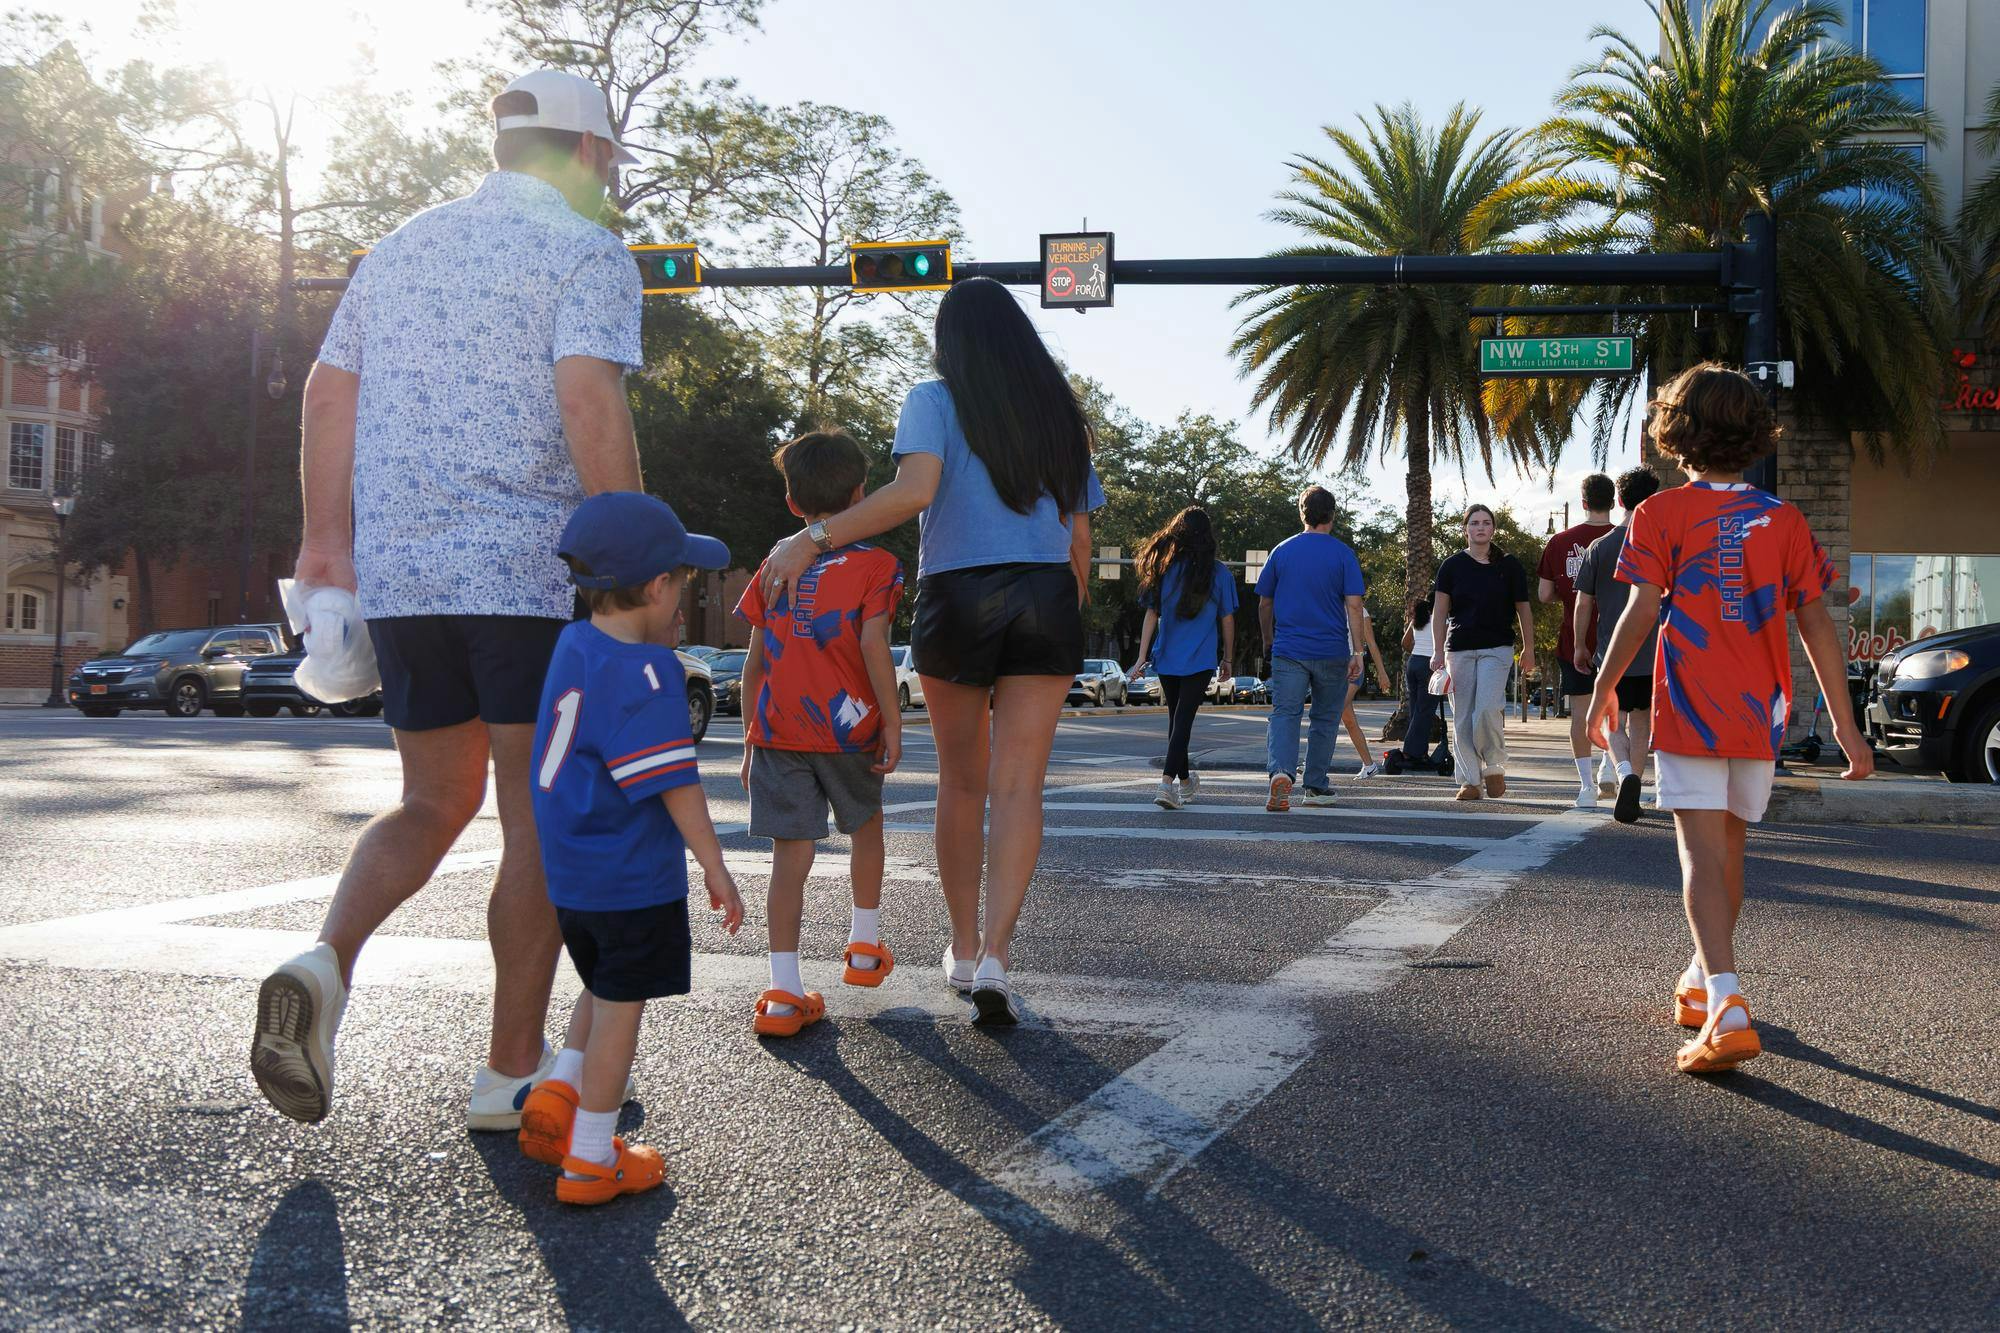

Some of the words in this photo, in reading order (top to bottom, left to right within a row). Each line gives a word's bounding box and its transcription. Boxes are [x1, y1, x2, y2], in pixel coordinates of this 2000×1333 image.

[1050, 242, 1087, 253] TURNING
[1049, 253, 1090, 264] VEHICLES
[1051, 276, 1071, 287] STOP
[1075, 285, 1092, 295] FOR
[1490, 342, 1526, 359] NW
[1539, 341, 1579, 359] 13TH
[1596, 340, 1625, 357] ST
[1500, 359, 1510, 367] Dr.
[1512, 359, 1535, 367] Martin
[1537, 358, 1560, 367] Luther
[1563, 358, 1579, 368] King
[1581, 358, 1592, 366] Jr.
[1718, 516, 1745, 622] GATORS
[643, 663, 660, 691] 1
[539, 688, 583, 792] 1
